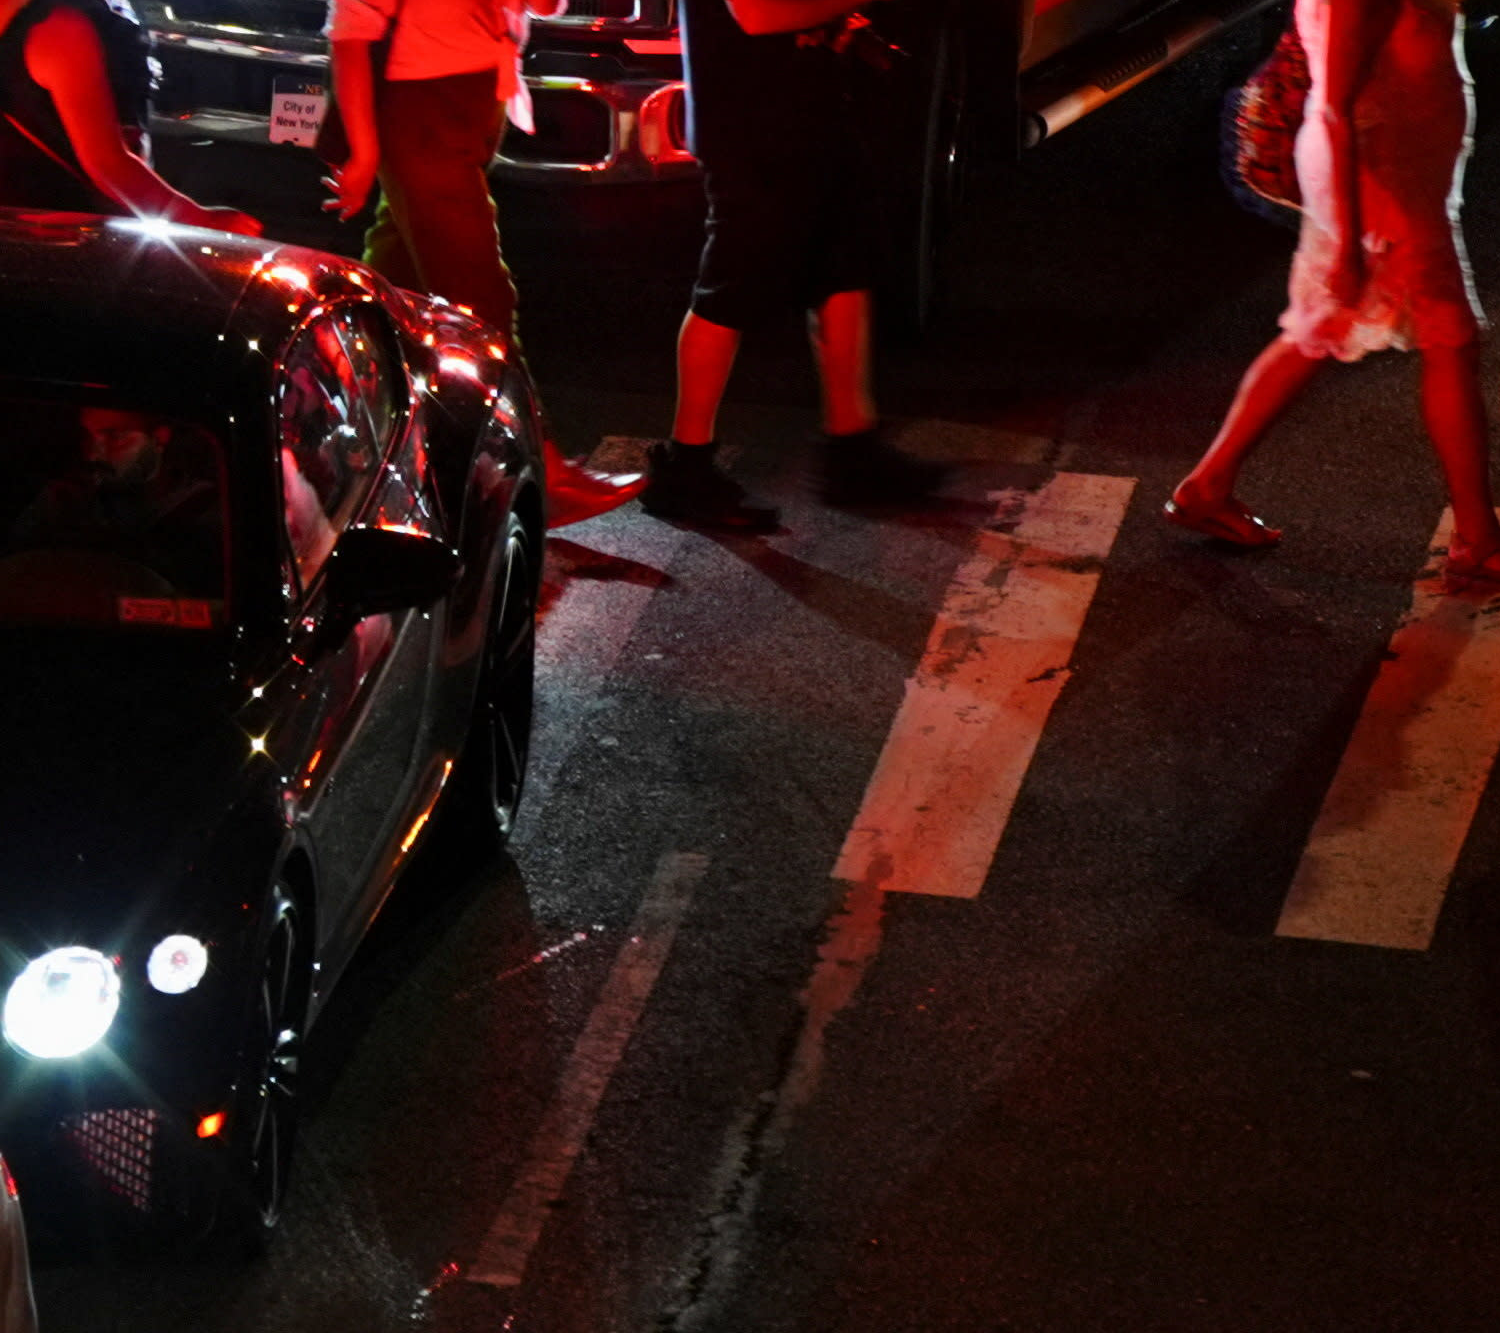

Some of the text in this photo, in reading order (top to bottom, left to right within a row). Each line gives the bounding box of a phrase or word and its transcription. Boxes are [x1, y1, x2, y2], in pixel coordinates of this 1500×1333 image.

[283, 99, 316, 117] City of
[276, 115, 298, 129] New
